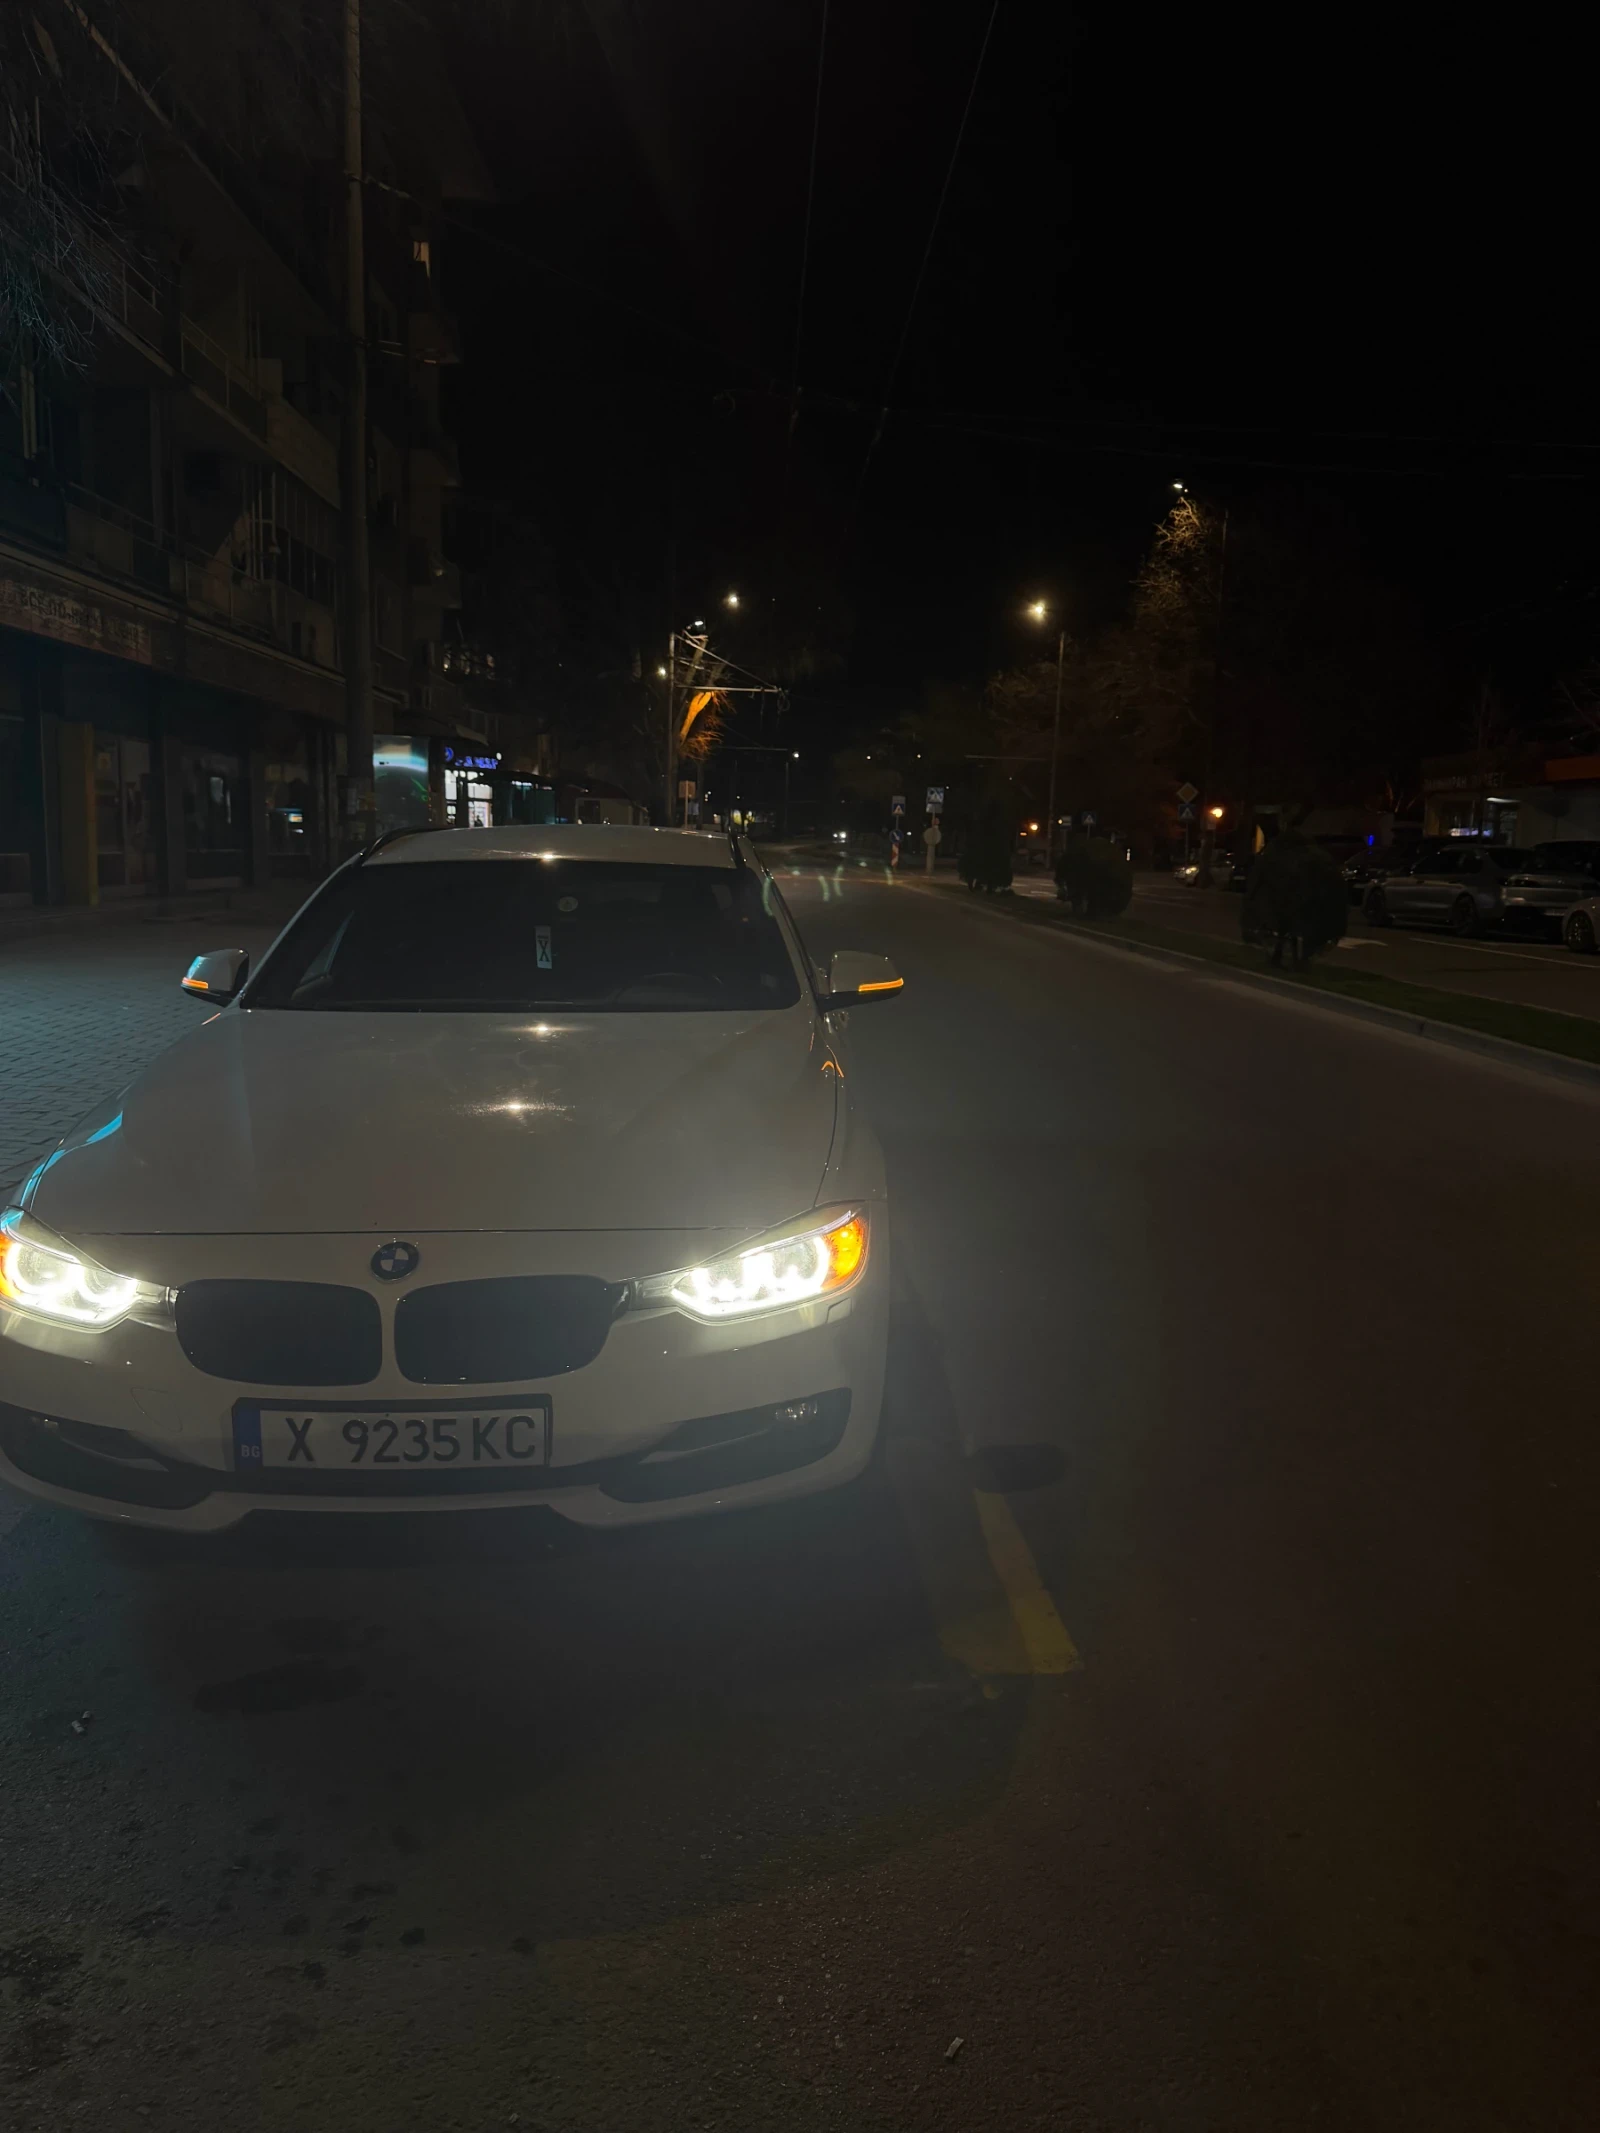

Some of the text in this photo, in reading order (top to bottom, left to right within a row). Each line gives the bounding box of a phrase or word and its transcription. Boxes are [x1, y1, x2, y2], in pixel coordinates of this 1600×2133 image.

[241, 1444, 261, 1458] BG
[285, 1415, 536, 1463] X 9235 KC
